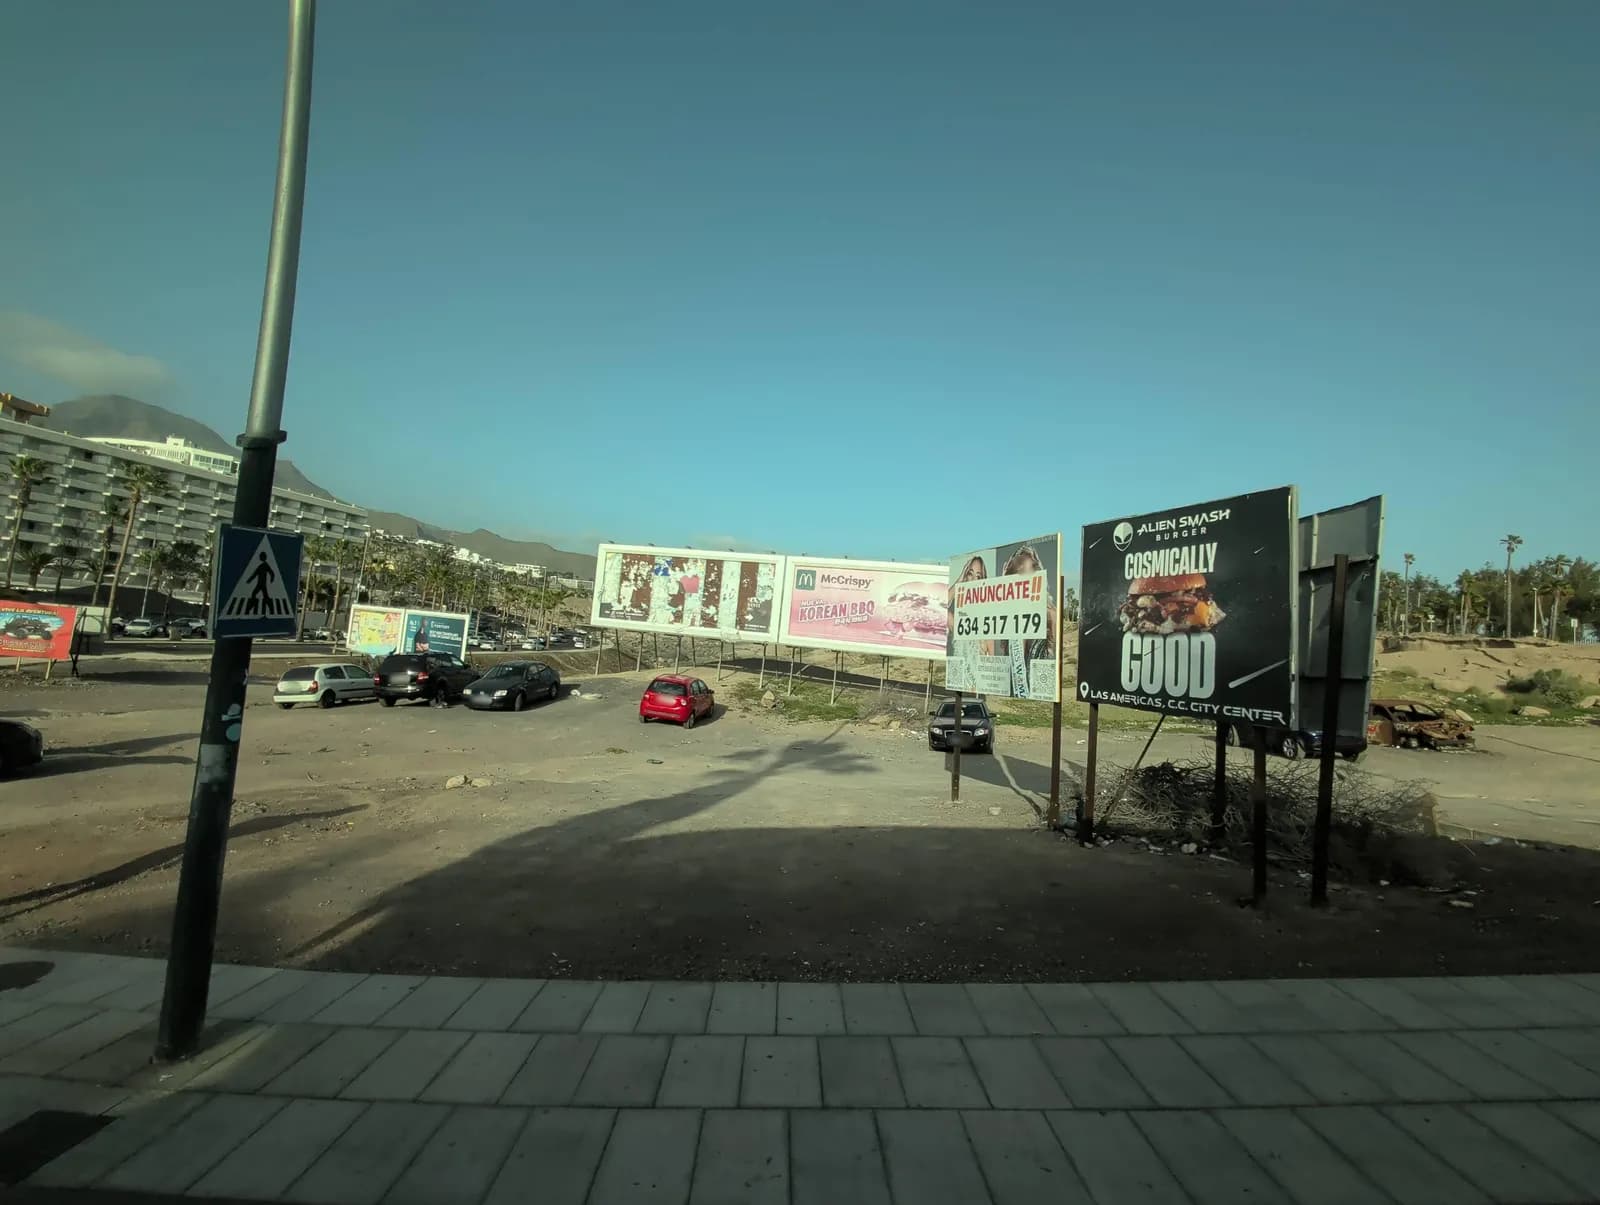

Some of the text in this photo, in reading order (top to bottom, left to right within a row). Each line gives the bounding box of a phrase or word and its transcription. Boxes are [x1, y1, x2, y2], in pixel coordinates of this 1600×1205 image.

[1137, 508, 1231, 536] ALIEN SMASH
[1155, 526, 1207, 541] BURGER
[1124, 541, 1218, 580] COSMICALLY
[820, 574, 872, 589] McCrispy
[799, 603, 848, 621] KOREAN
[850, 600, 875, 615] BBQ
[957, 612, 1041, 636] 634 517 179
[1121, 632, 1216, 699] GOOD
[1090, 690, 1109, 700] LAS
[1190, 702, 1220, 715] CITY
[1222, 705, 1287, 726] CENTER
